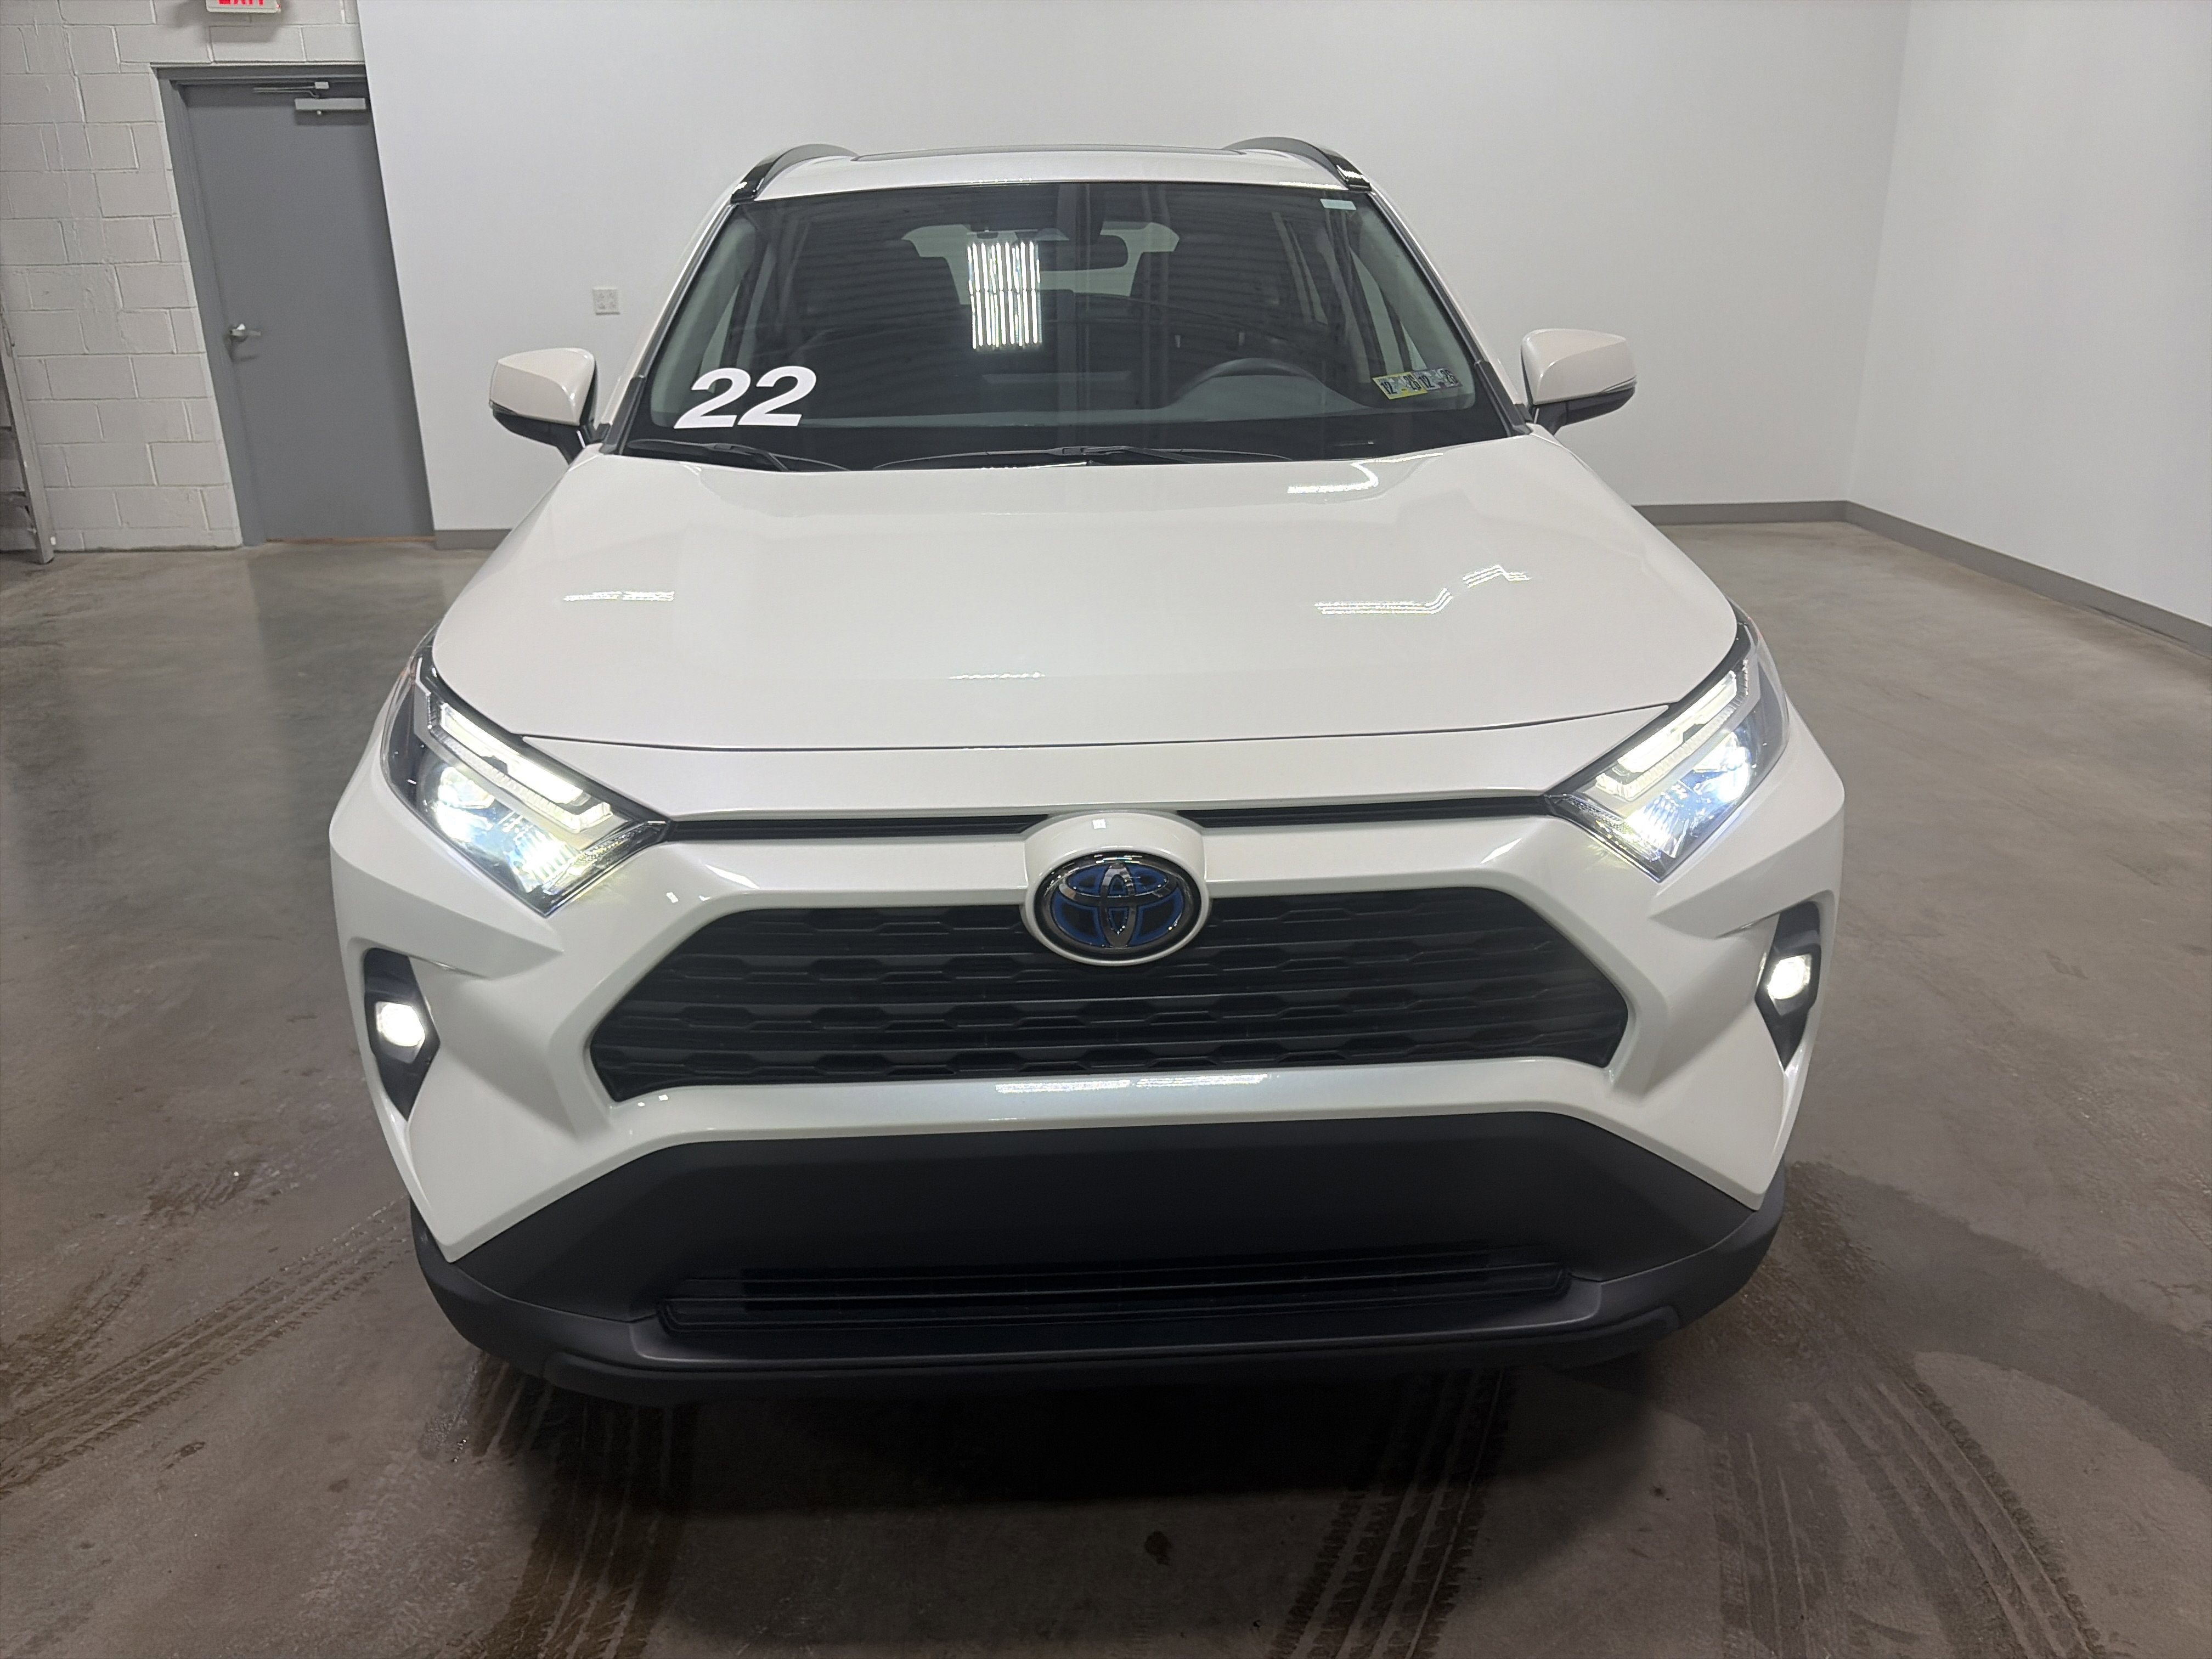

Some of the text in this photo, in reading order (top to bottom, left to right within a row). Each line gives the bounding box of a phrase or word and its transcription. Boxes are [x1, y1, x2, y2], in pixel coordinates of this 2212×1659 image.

[1380, 381, 1397, 394] 12
[1418, 375, 1435, 388] 12
[674, 366, 816, 428] 22
